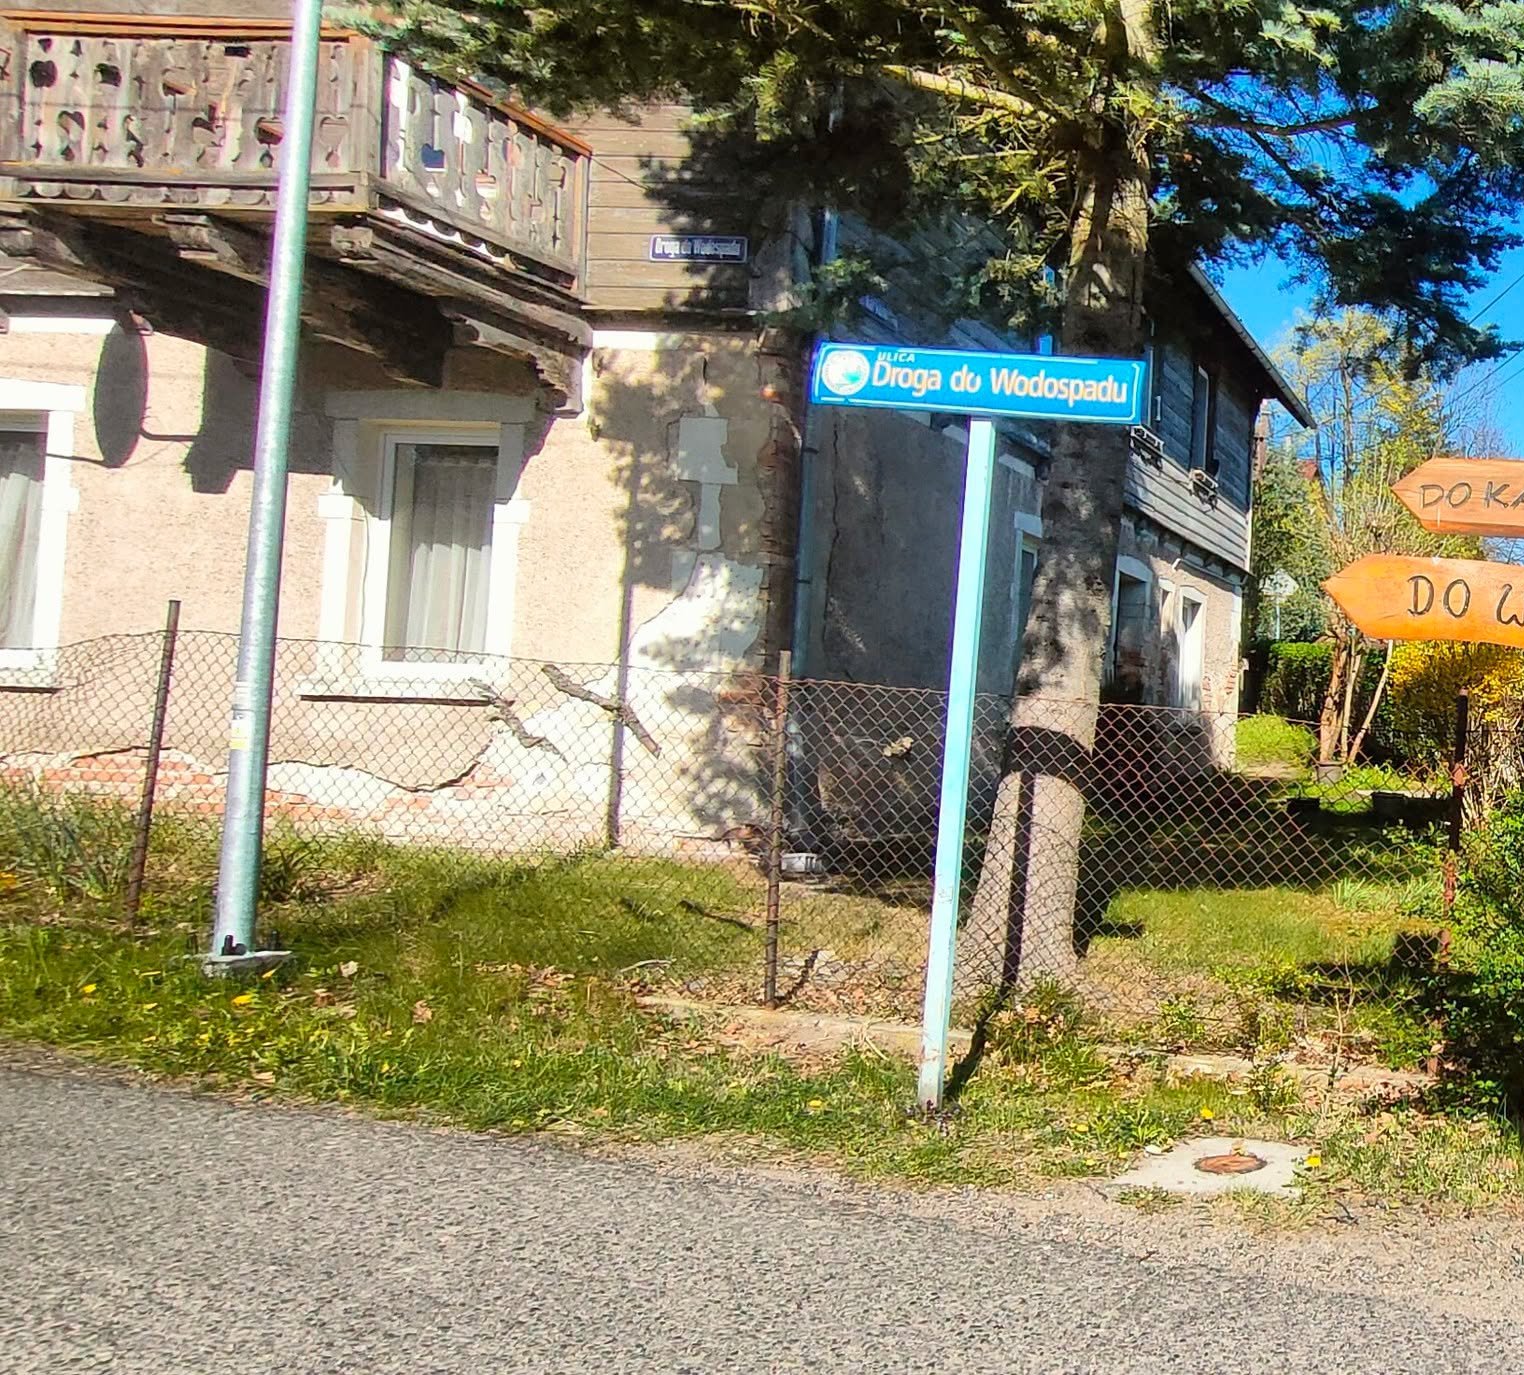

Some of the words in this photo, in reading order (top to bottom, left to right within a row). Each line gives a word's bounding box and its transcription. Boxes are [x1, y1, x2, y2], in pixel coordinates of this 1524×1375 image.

[877, 351, 916, 364] ULICA
[872, 360, 942, 398] Droga
[950, 363, 982, 394] do
[989, 367, 1129, 408] Wodospadu
[1419, 481, 1472, 509] DO
[1407, 574, 1472, 619] DO
